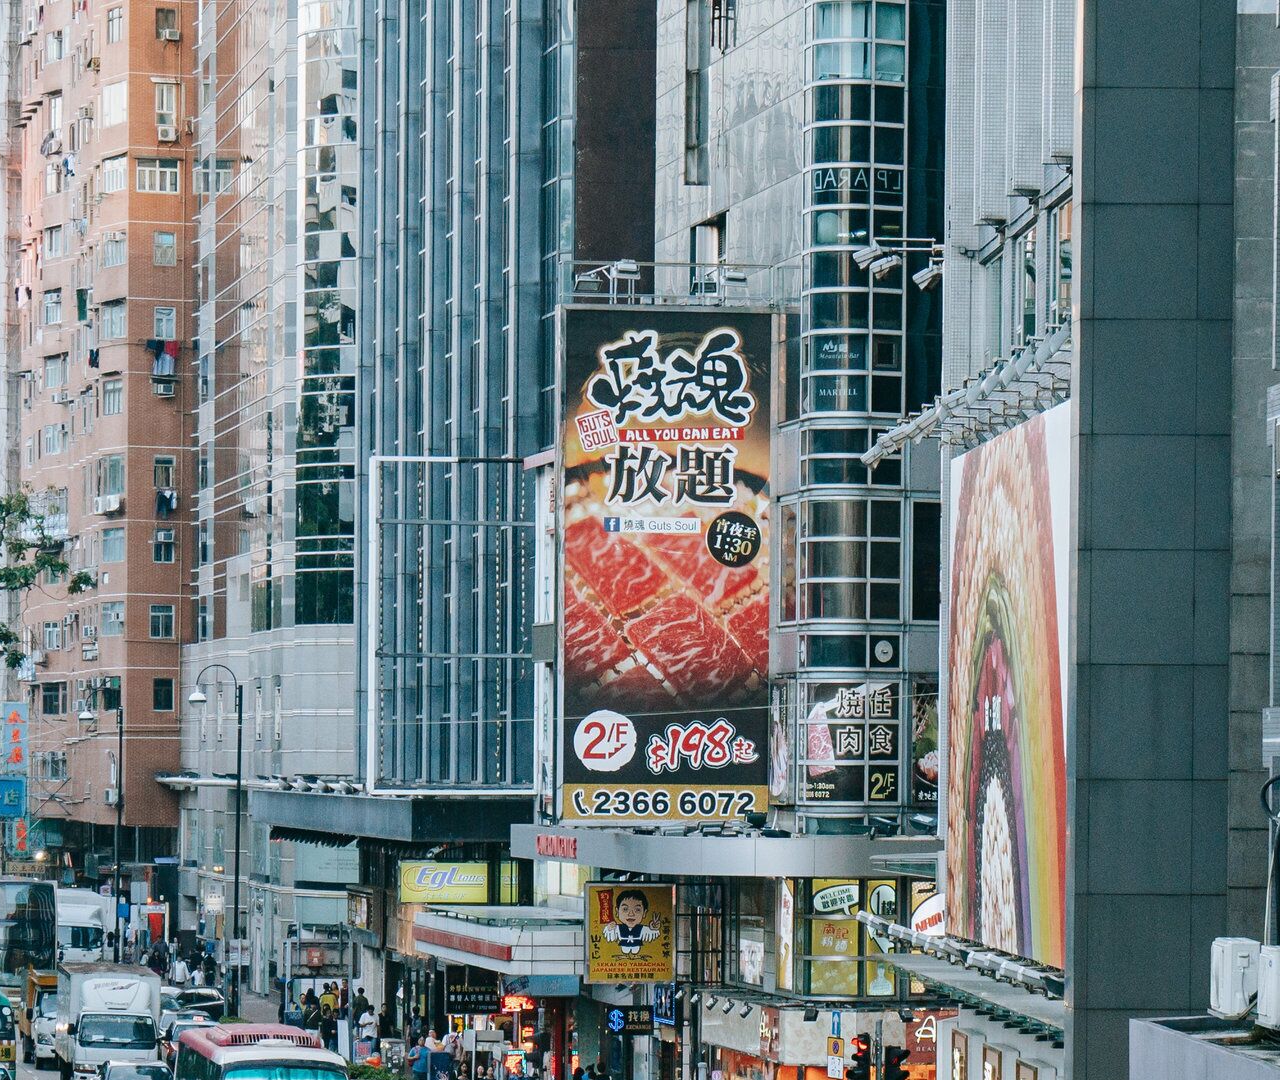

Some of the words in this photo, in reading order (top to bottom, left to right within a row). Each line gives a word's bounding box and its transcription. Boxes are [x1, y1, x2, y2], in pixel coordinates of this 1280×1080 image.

[580, 413, 611, 433] GUTS
[585, 430, 617, 449] SOUL
[626, 429, 650, 441] ALL
[655, 429, 679, 441] YOU
[683, 429, 709, 441] CAN
[713, 427, 739, 440] EAT
[607, 444, 735, 505] 放題
[649, 520, 672, 532] Guts
[675, 520, 697, 532] Soul
[713, 533, 753, 557] 1:30
[721, 552, 739, 564] AM
[593, 791, 674, 815] 2366
[677, 791, 755, 815] 6072
[820, 888, 852, 901] WELCOME
[822, 923, 849, 940] 南記
